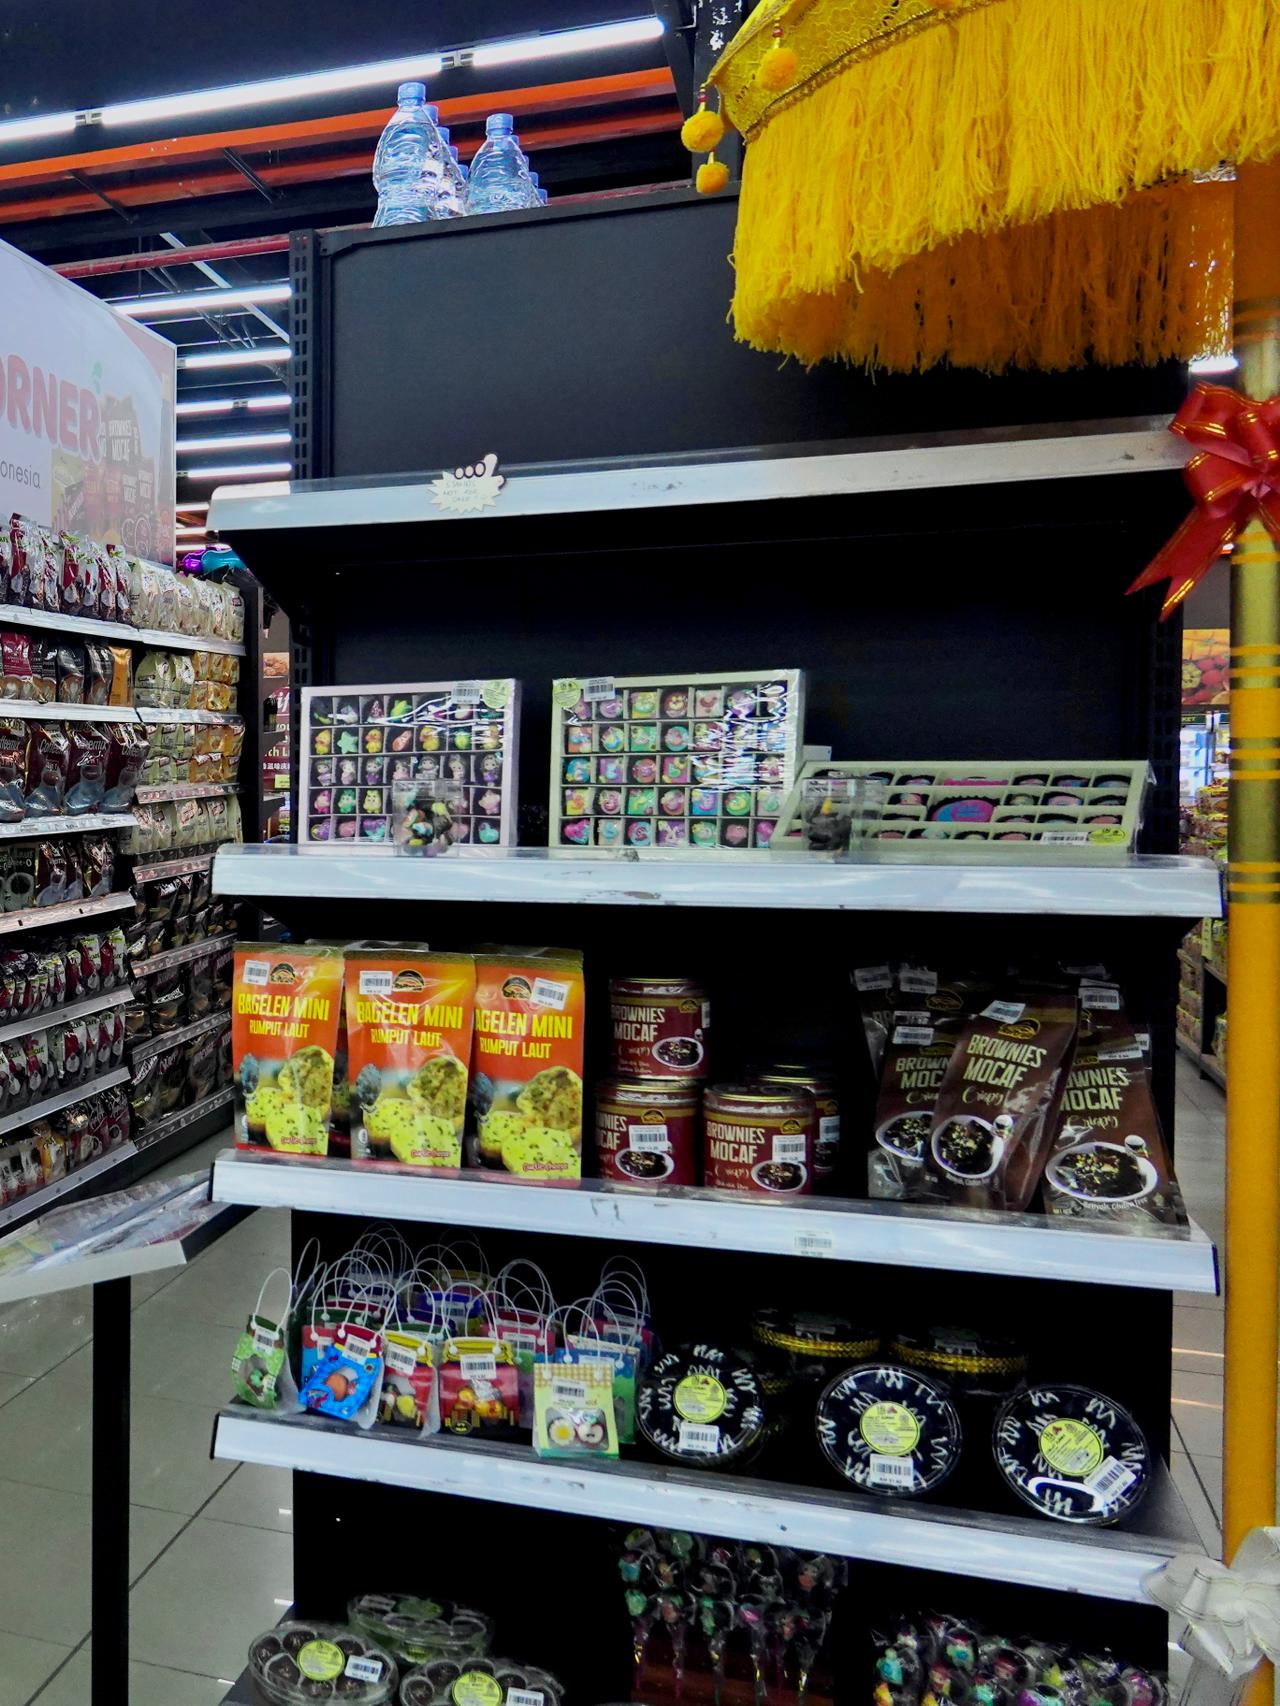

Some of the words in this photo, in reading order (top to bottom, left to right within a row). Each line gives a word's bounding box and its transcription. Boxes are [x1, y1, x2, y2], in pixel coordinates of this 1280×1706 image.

[238, 992, 290, 1018] BAGELEN
[293, 996, 330, 1022] MINI
[356, 1001, 418, 1026] BAGELEN
[423, 1004, 463, 1030] MINI
[610, 1004, 666, 1023] BROWNIES
[249, 1019, 282, 1036] RUMPUT
[284, 1021, 310, 1039] LAUT
[475, 1008, 527, 1037] AGELEN
[531, 1014, 573, 1040] MINI
[613, 1022, 658, 1042] MOCAF
[371, 1028, 410, 1047] RUMPUT
[413, 1030, 442, 1048] LAUT
[480, 1037, 518, 1058] RUMPUT
[522, 1040, 552, 1060] LAUT
[966, 1034, 1047, 1068] BROWNIES
[895, 1056, 952, 1073] BROWN
[963, 1057, 1028, 1089] MOCAF
[900, 1070, 943, 1089] MOC
[706, 1120, 766, 1145] BROWNIES
[710, 1139, 758, 1165] MOCAF
